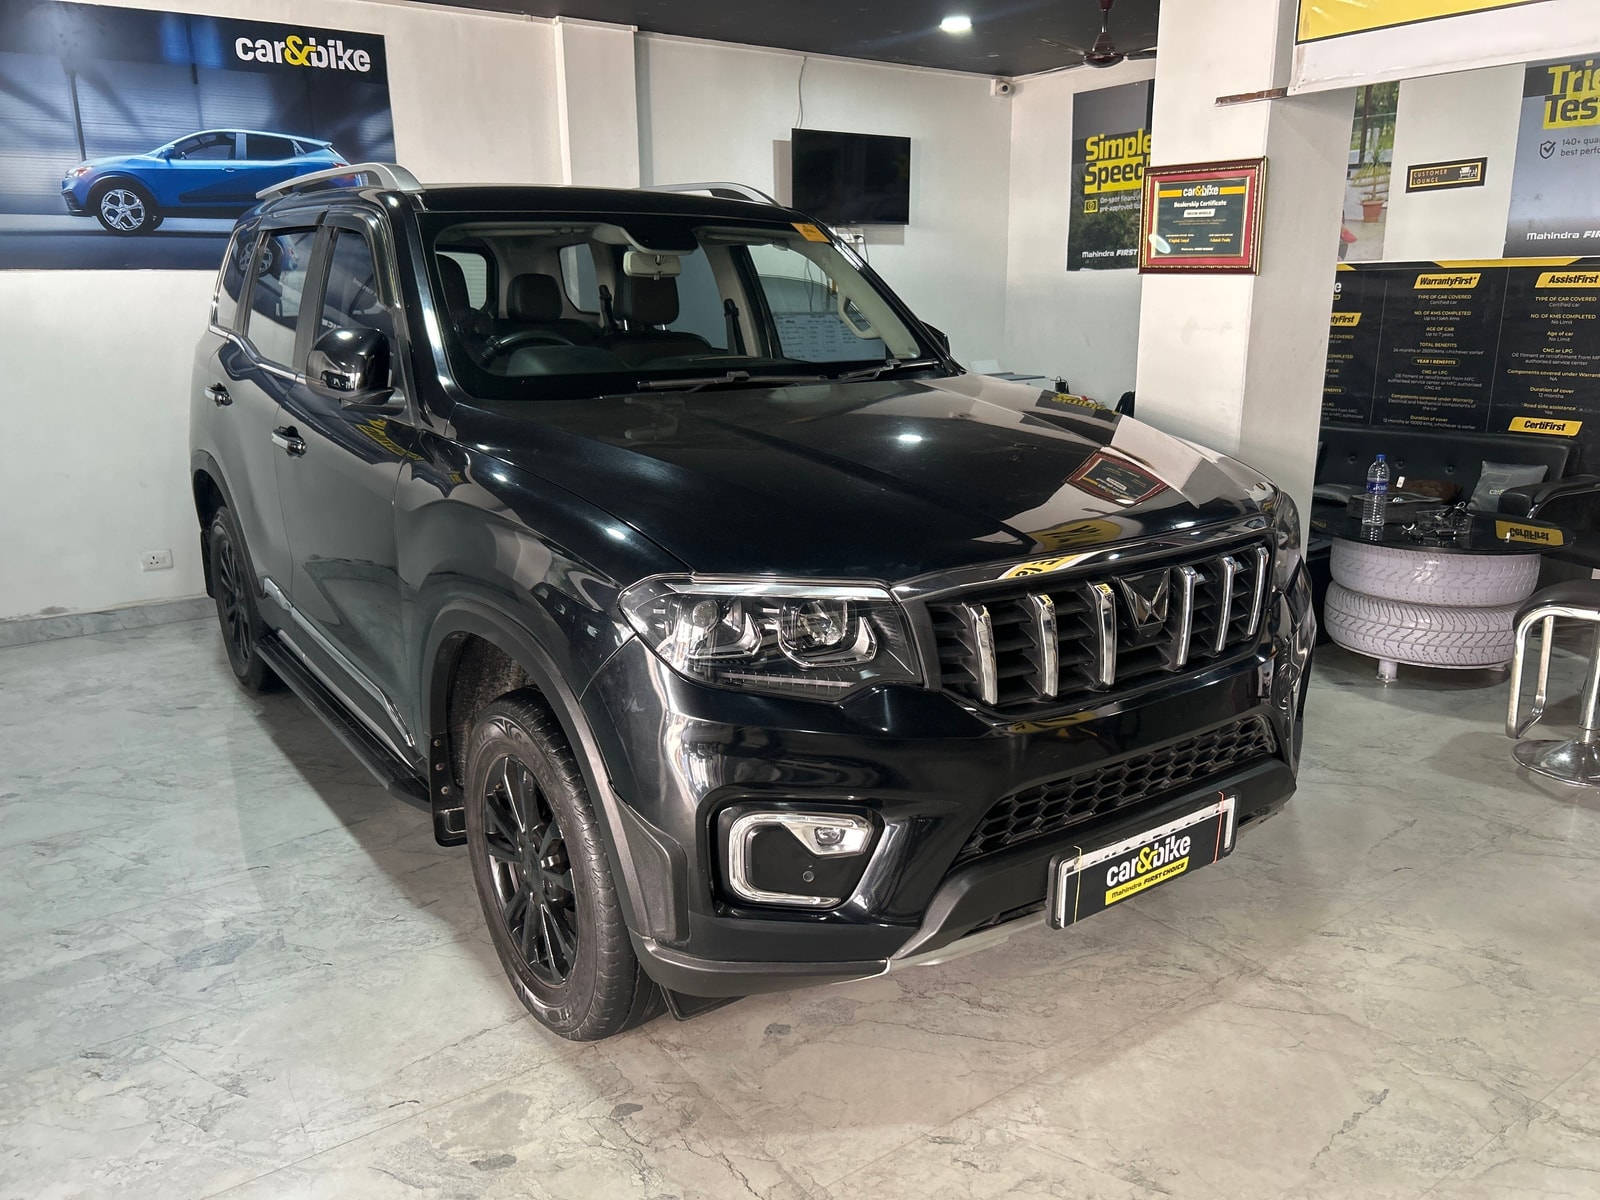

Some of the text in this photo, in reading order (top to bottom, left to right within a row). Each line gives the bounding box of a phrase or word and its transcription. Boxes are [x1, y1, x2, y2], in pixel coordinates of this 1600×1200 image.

[235, 35, 371, 73] car&bike
[1413, 168, 1448, 178] CUSTOMER
[1413, 177, 1439, 185] LOUNGE
[1183, 185, 1219, 197] car&bike
[1527, 231, 1580, 241] Mahindra
[1082, 250, 1115, 258] Mahindra
[1548, 275, 1599, 284] AssistFirst
[1524, 420, 1566, 431] CertiFirst
[1106, 835, 1191, 887] car&bike
[1111, 862, 1186, 899] Mahindra FIRST CHOICE
